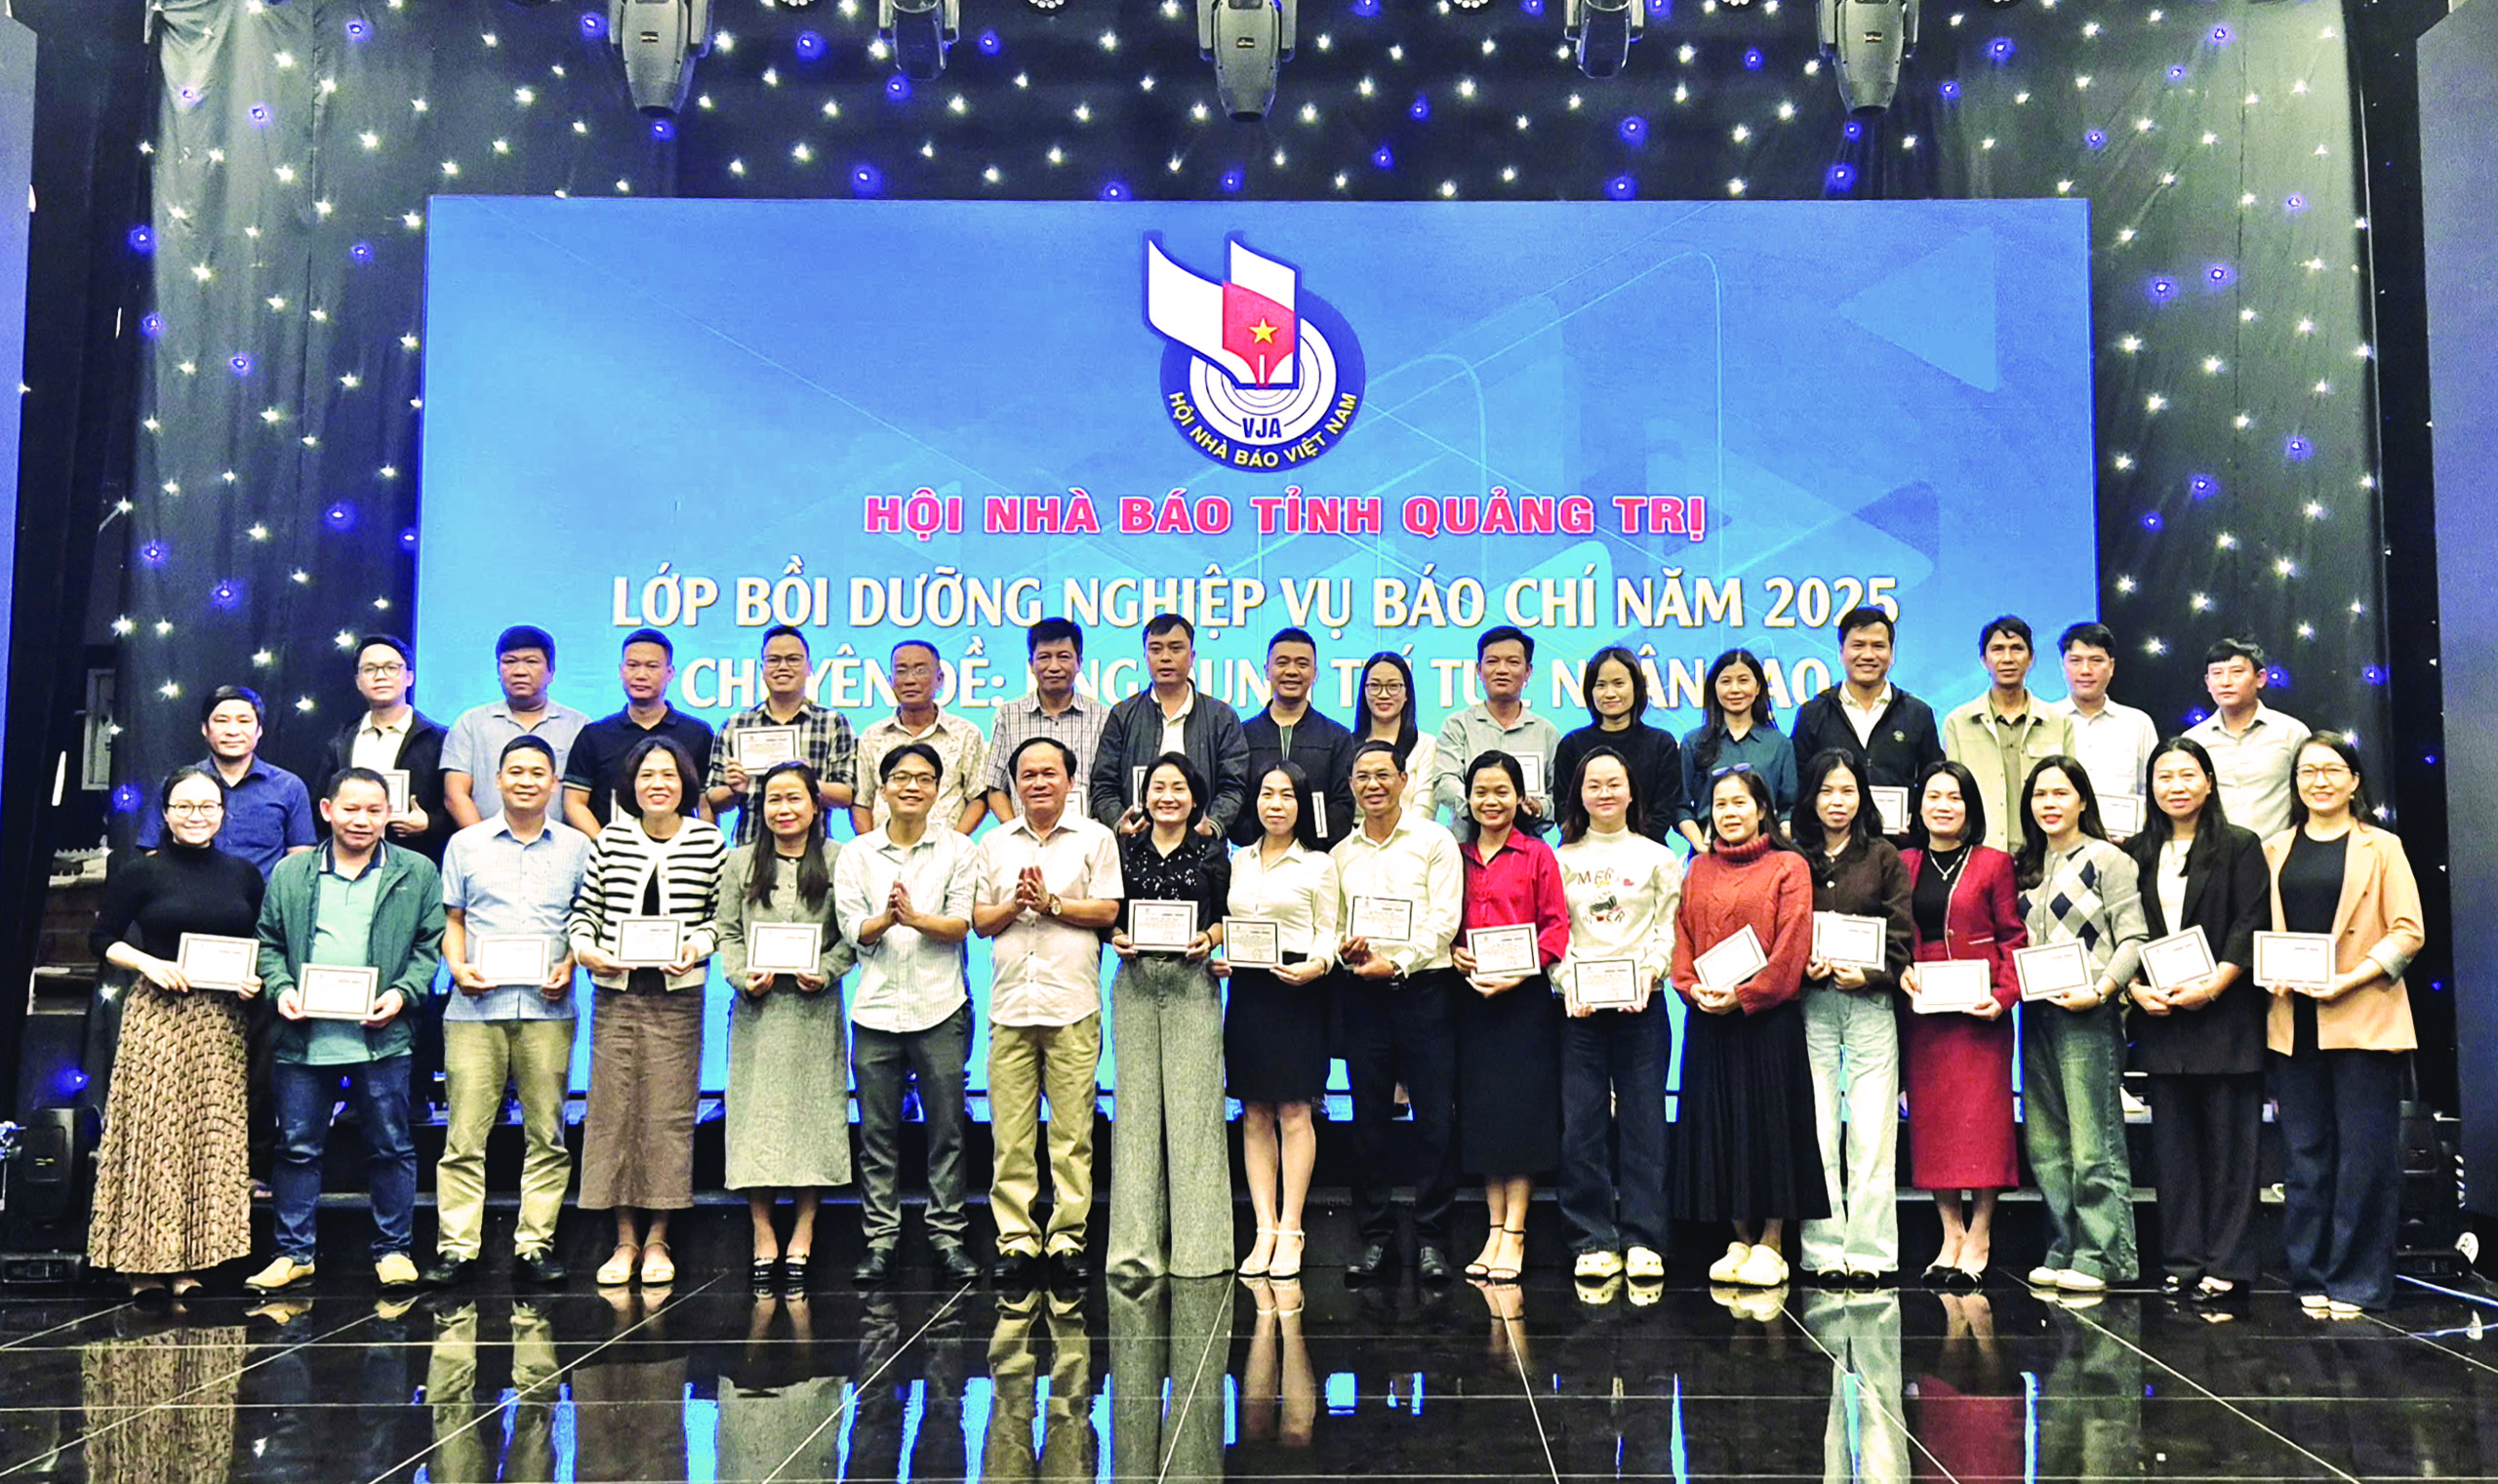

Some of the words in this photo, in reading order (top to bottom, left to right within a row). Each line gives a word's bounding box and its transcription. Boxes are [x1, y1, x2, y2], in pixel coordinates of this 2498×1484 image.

[1169, 391, 1195, 426] HỘI
[1189, 424, 1229, 460] NHÀ
[1233, 448, 1279, 467] BÁO
[1283, 430, 1327, 463] VIỆT
[1324, 392, 1357, 435] NAM
[1241, 418, 1282, 438] VJA
[866, 488, 961, 540] HỘI
[985, 488, 1099, 534] NHÀ
[1120, 488, 1230, 534] BÁO
[1250, 486, 1381, 535] TỈNH
[1403, 486, 1595, 536] QUẢNG
[1613, 496, 1704, 541] TRỊ
[613, 561, 719, 627] LỚP
[736, 554, 828, 627] BỒI
[849, 565, 1042, 627] DƯỠNG
[1064, 563, 1267, 640] NGHIỆP
[1279, 578, 1351, 640] VỤ
[1373, 562, 1486, 628] BÁO
[1504, 562, 1596, 628] CHÍ
[1616, 567, 1745, 628] NĂM
[1763, 577, 1900, 628] 2025
[681, 643, 900, 709] CHYÊN
[1026, 659, 1140, 708] NG
[1551, 643, 1705, 709] NÂN
